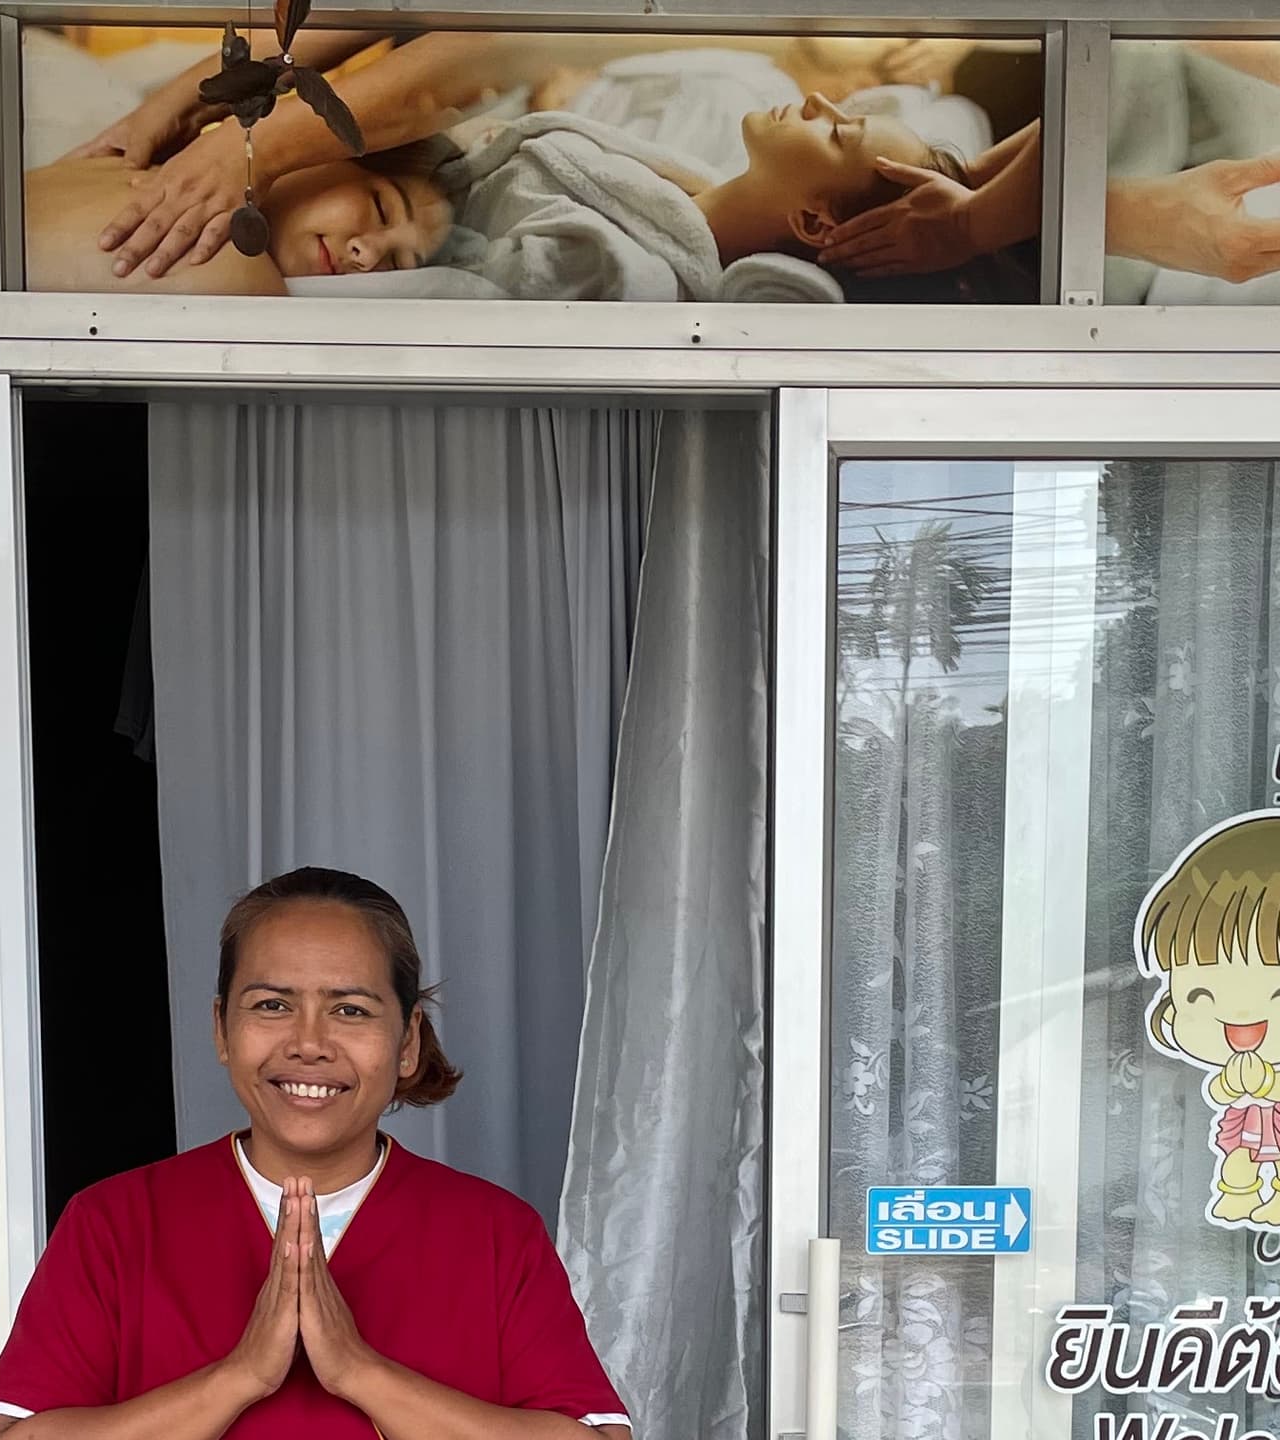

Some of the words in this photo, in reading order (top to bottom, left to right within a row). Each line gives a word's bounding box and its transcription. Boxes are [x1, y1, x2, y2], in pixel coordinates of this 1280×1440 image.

[877, 1190, 996, 1222] เลื่อน
[876, 1228, 997, 1250] SLIDE
